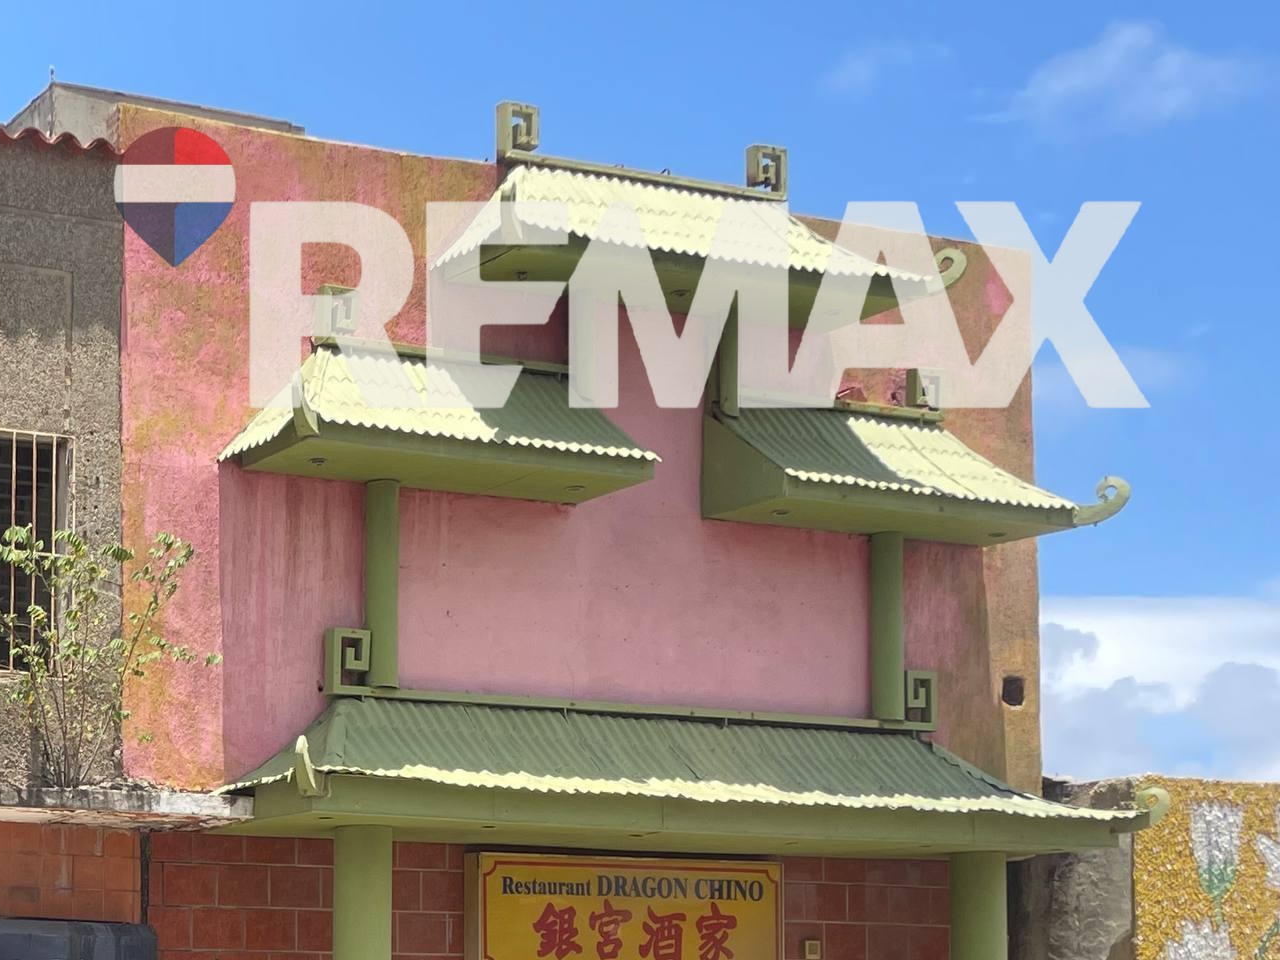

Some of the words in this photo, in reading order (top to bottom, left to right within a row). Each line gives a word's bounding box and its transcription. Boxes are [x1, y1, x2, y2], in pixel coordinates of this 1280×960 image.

[501, 875, 591, 897] Restaurant
[596, 875, 688, 899] DRAGON
[694, 878, 764, 902] CHINO
